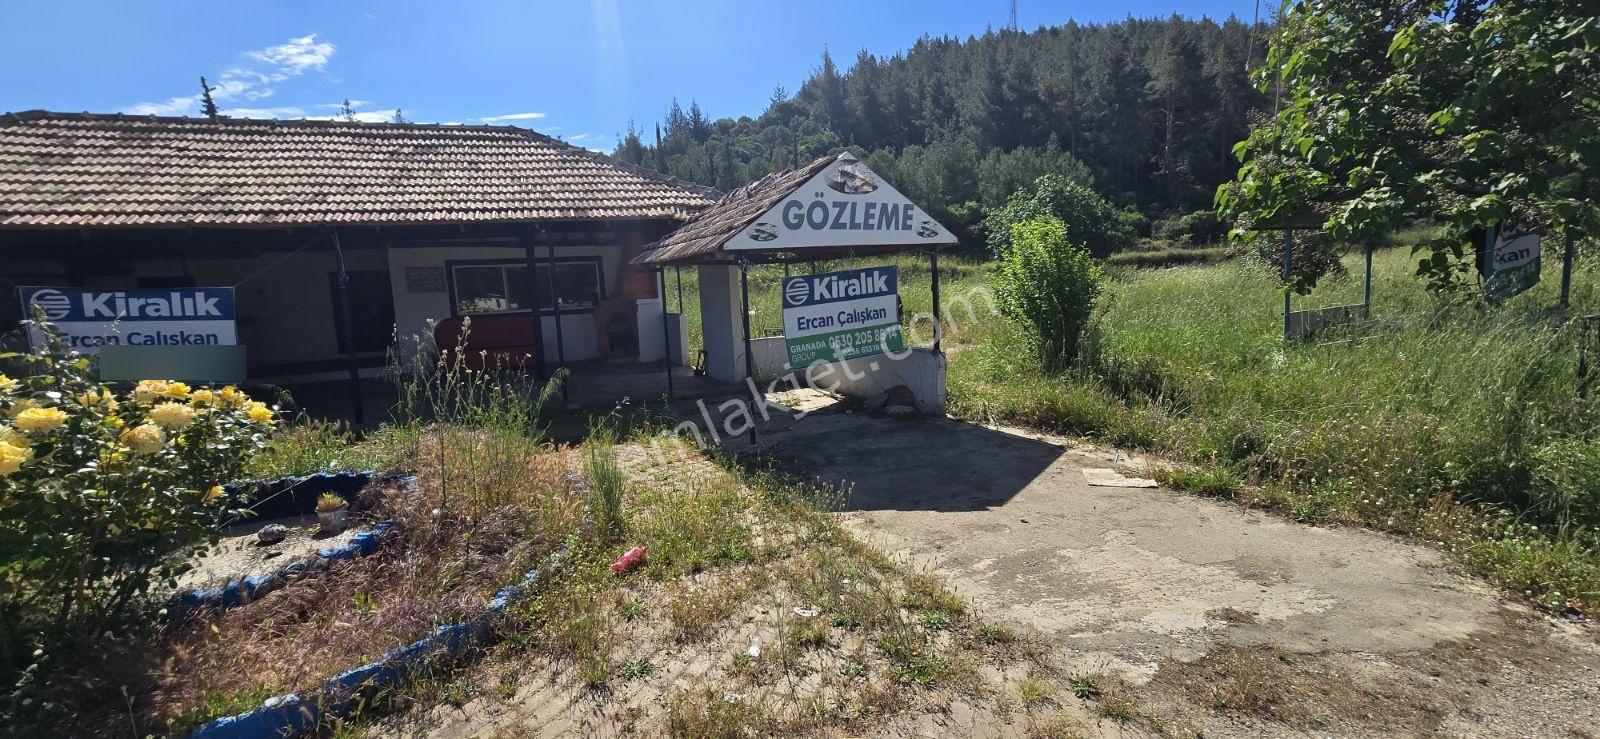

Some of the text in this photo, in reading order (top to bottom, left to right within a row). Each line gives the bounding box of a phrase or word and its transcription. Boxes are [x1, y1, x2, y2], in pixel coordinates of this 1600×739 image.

[782, 192, 914, 230] GÖZLEME
[813, 271, 888, 300] Kiralık
[82, 292, 221, 317] Kiralık
[797, 308, 887, 331] Ercan Çalışkan
[790, 340, 826, 353] GRANADA
[855, 330, 873, 345] 205
[790, 351, 816, 363] GROUP
